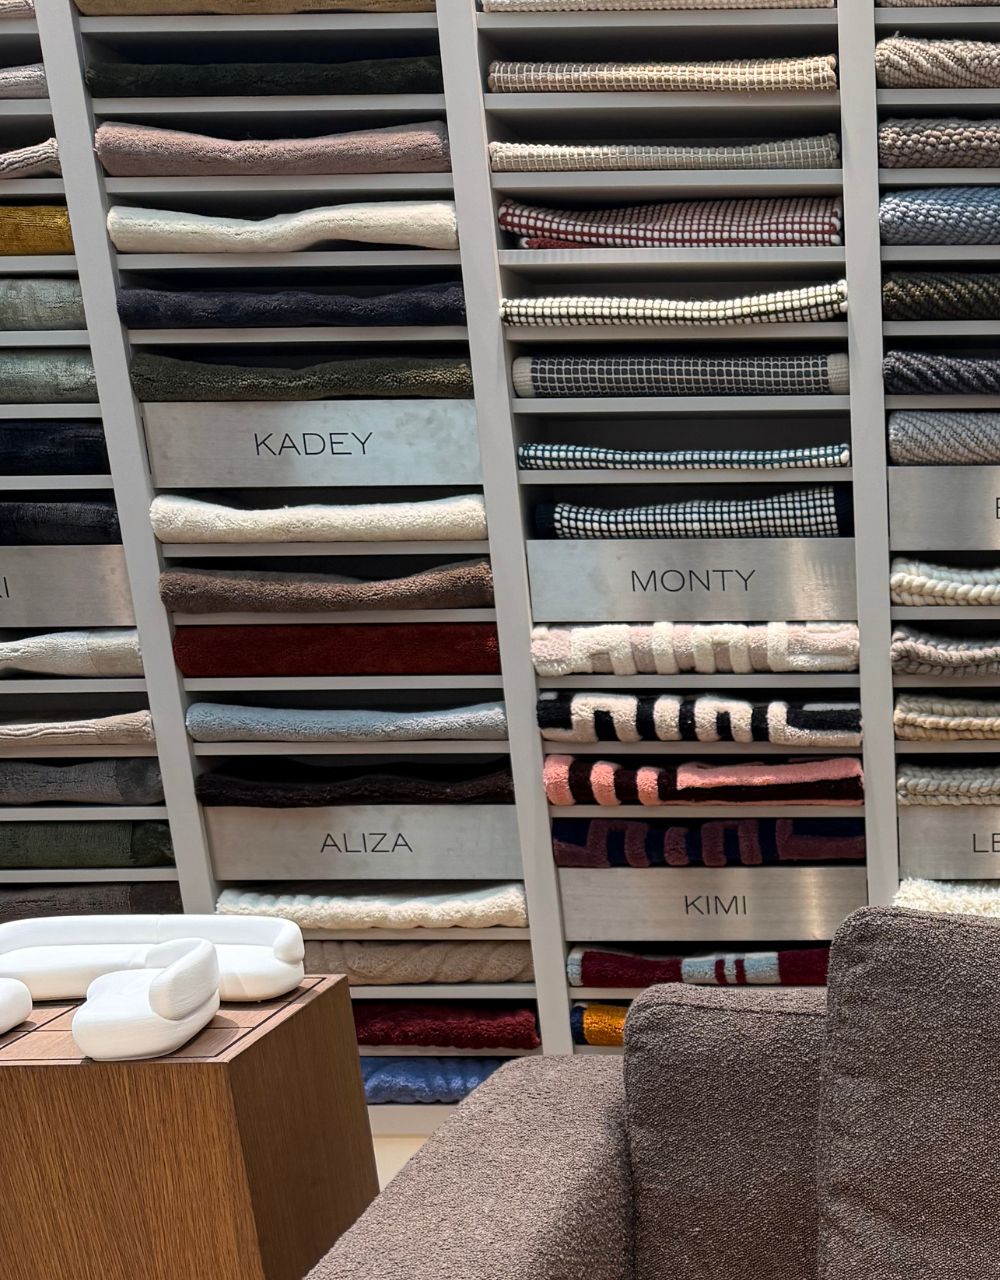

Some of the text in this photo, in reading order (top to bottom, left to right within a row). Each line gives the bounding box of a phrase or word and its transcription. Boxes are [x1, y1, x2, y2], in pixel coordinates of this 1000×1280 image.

[253, 431, 374, 457] KADEY
[630, 569, 756, 593] MONTY
[320, 832, 414, 854] ALIZA
[684, 895, 747, 916] KIMI
